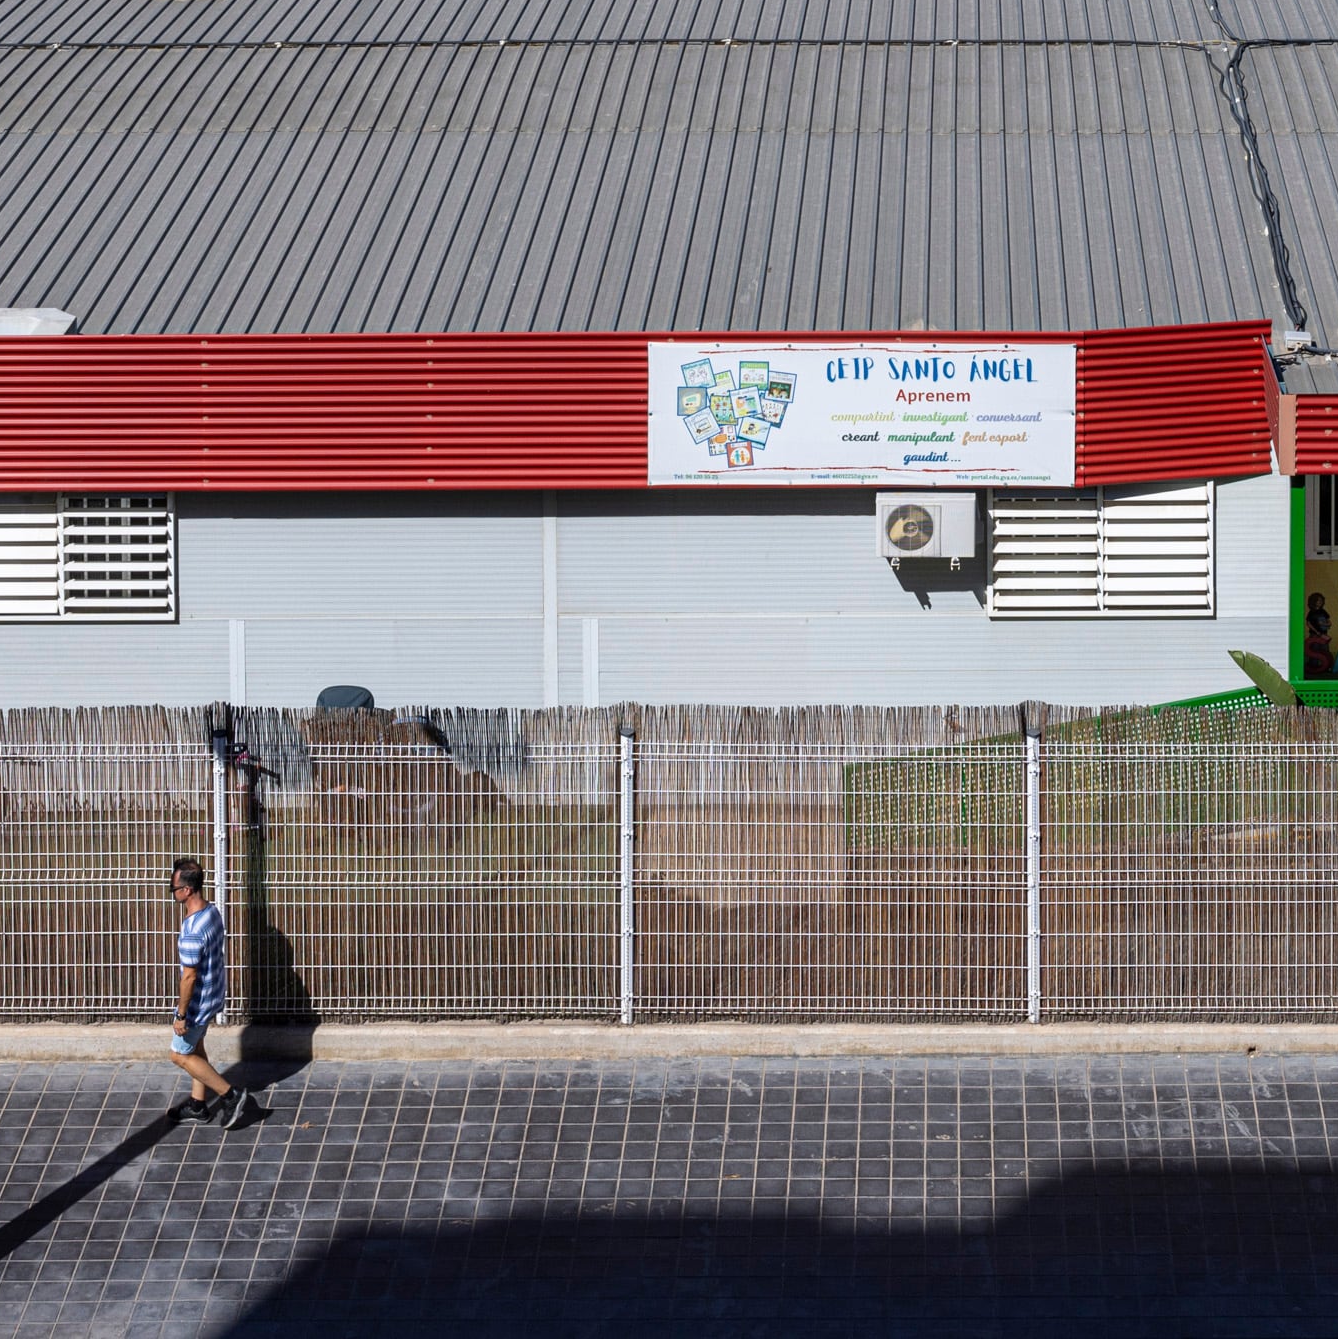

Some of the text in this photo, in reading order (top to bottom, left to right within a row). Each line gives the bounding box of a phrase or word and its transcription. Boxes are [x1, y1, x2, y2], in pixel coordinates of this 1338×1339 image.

[826, 355, 1038, 382] CEIP SANTO ÁNGEL
[896, 388, 971, 404] Aprenem
[831, 411, 1042, 426] compartint investigant conversant
[841, 431, 1028, 446] creant manipulant fent esport
[903, 451, 949, 465] gaudint
